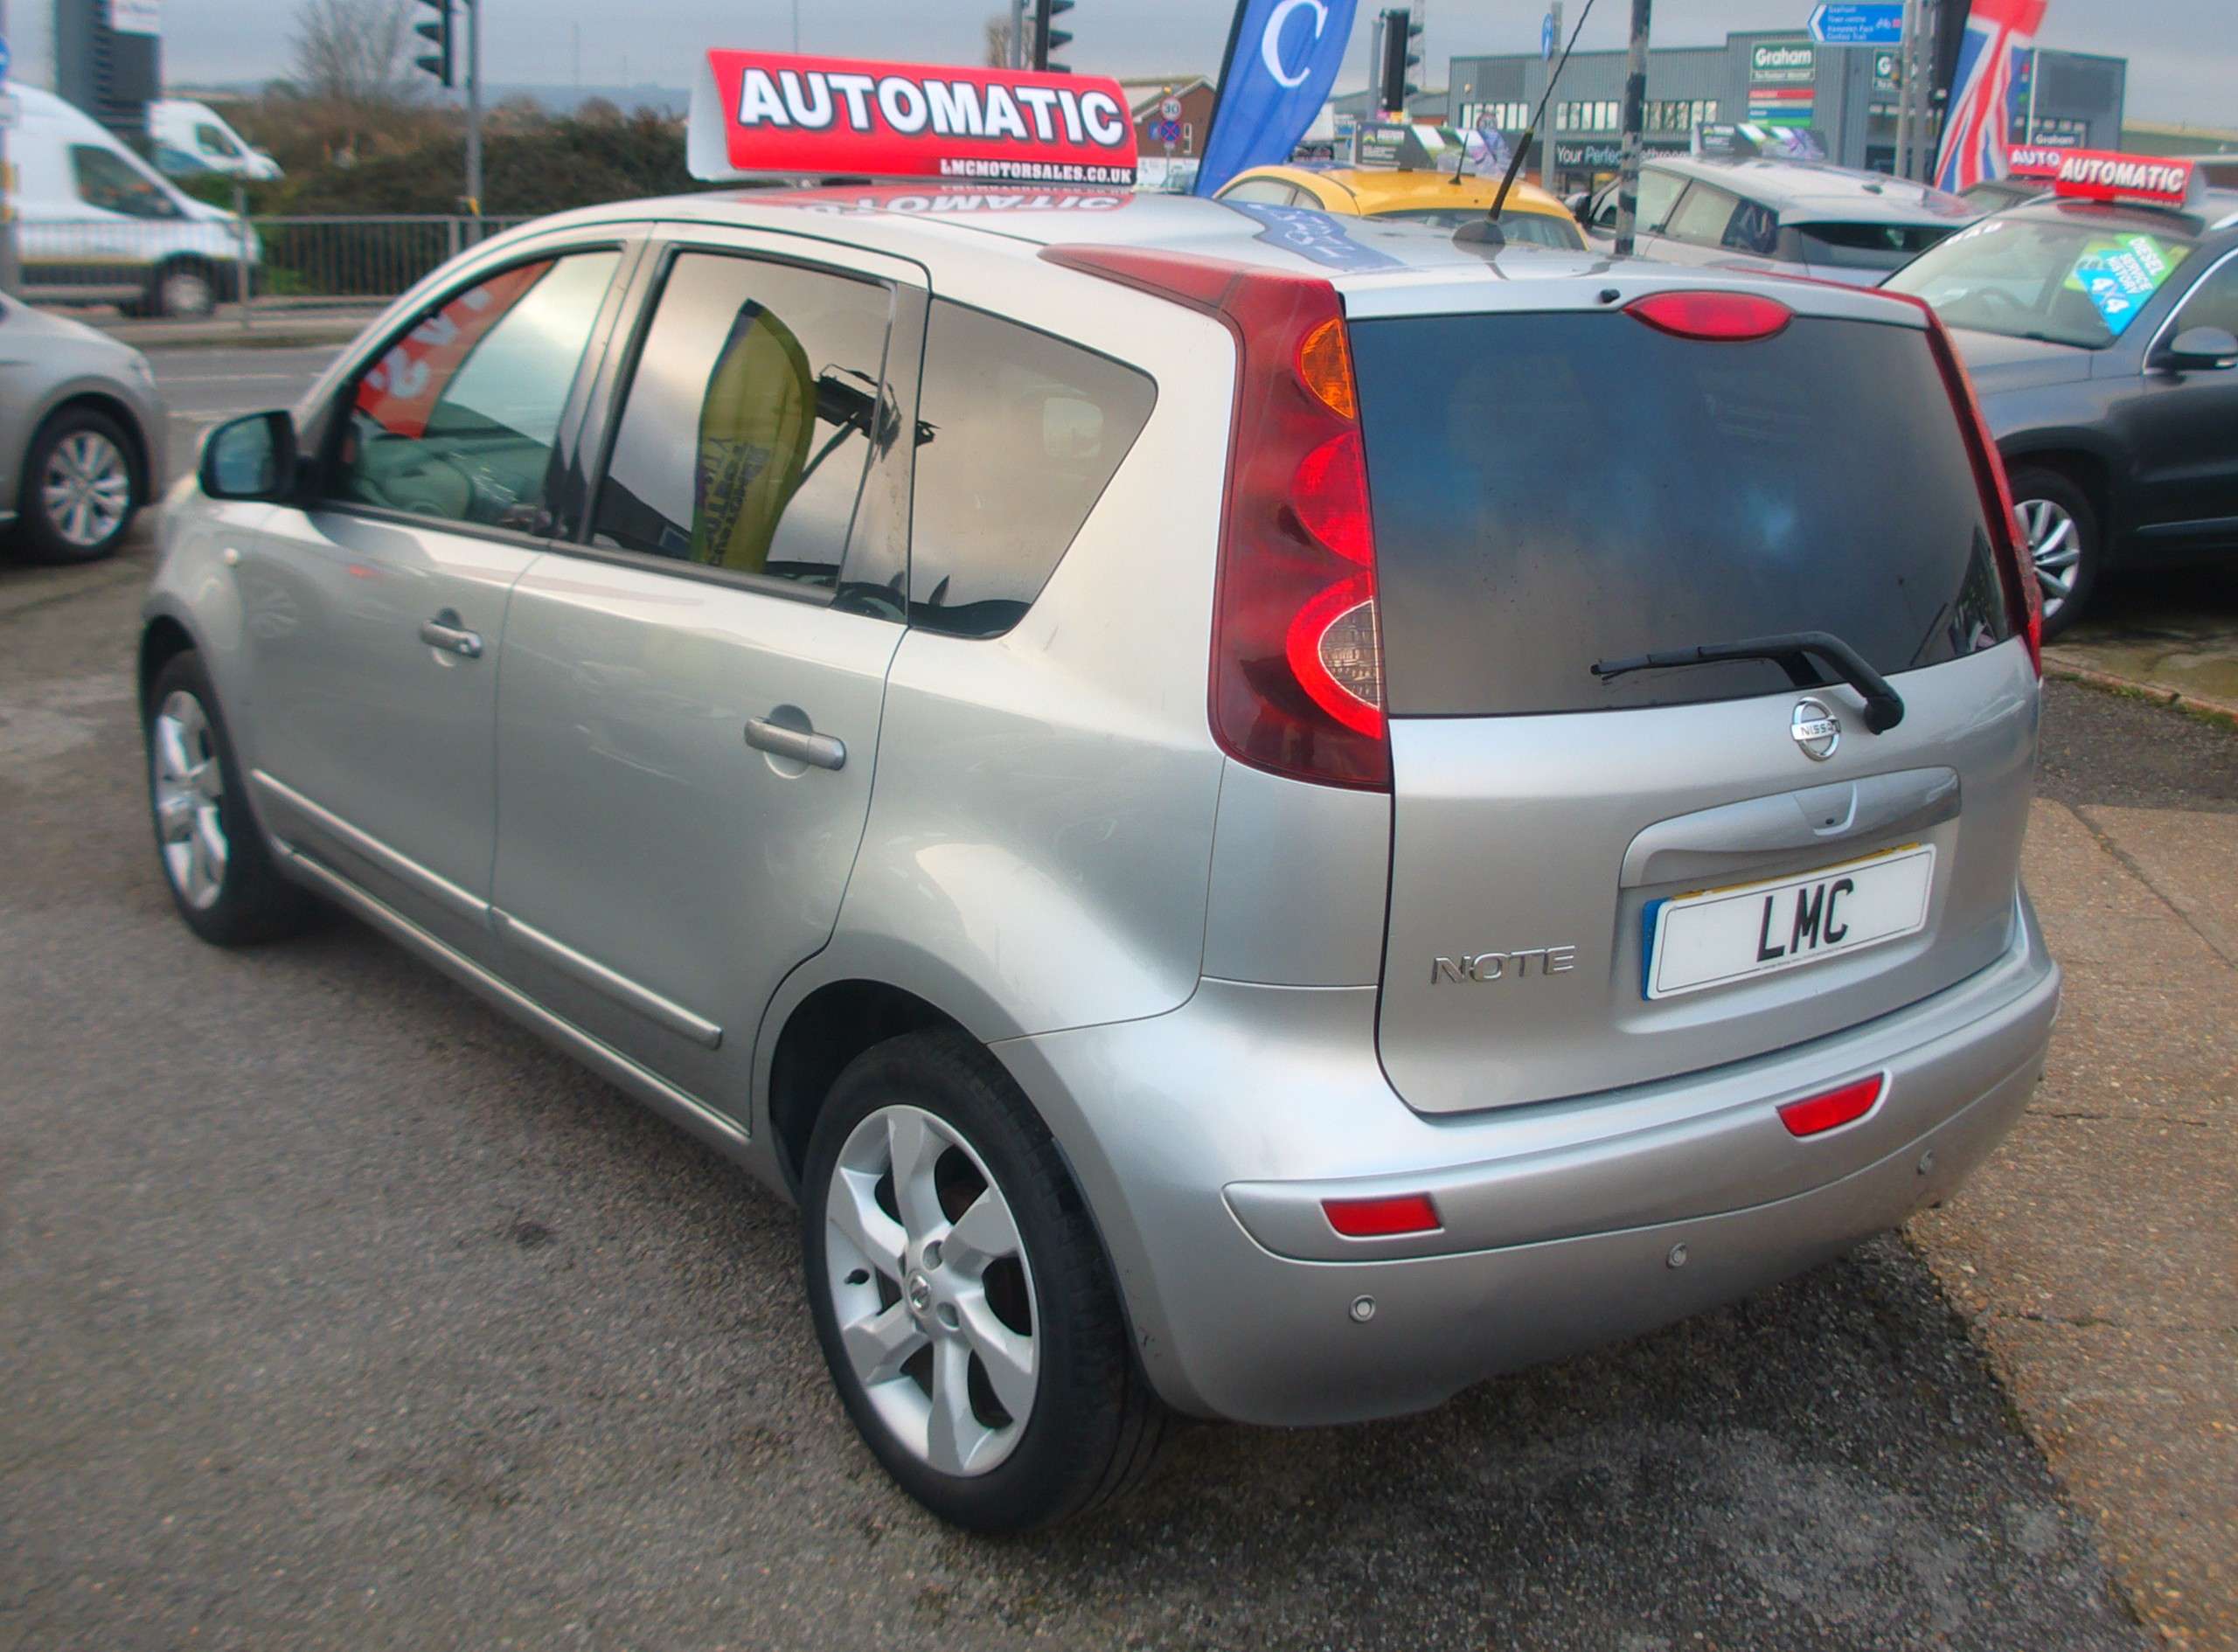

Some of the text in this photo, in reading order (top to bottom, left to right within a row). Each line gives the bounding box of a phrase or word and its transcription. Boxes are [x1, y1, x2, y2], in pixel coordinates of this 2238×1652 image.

[1261, 0, 1329, 87] C
[1755, 46, 1812, 66] Graham
[739, 67, 1126, 147] AUTOMATIC
[1556, 145, 1582, 163] Your
[1584, 145, 1621, 164] Perfec
[2035, 133, 2075, 144] Graham
[940, 157, 1132, 184] LMCMOTORSALES.CO.UK
[2059, 157, 2185, 193] AUTOMATIC
[1756, 878, 1853, 962] LMC
[1430, 945, 1574, 985] NOTE
